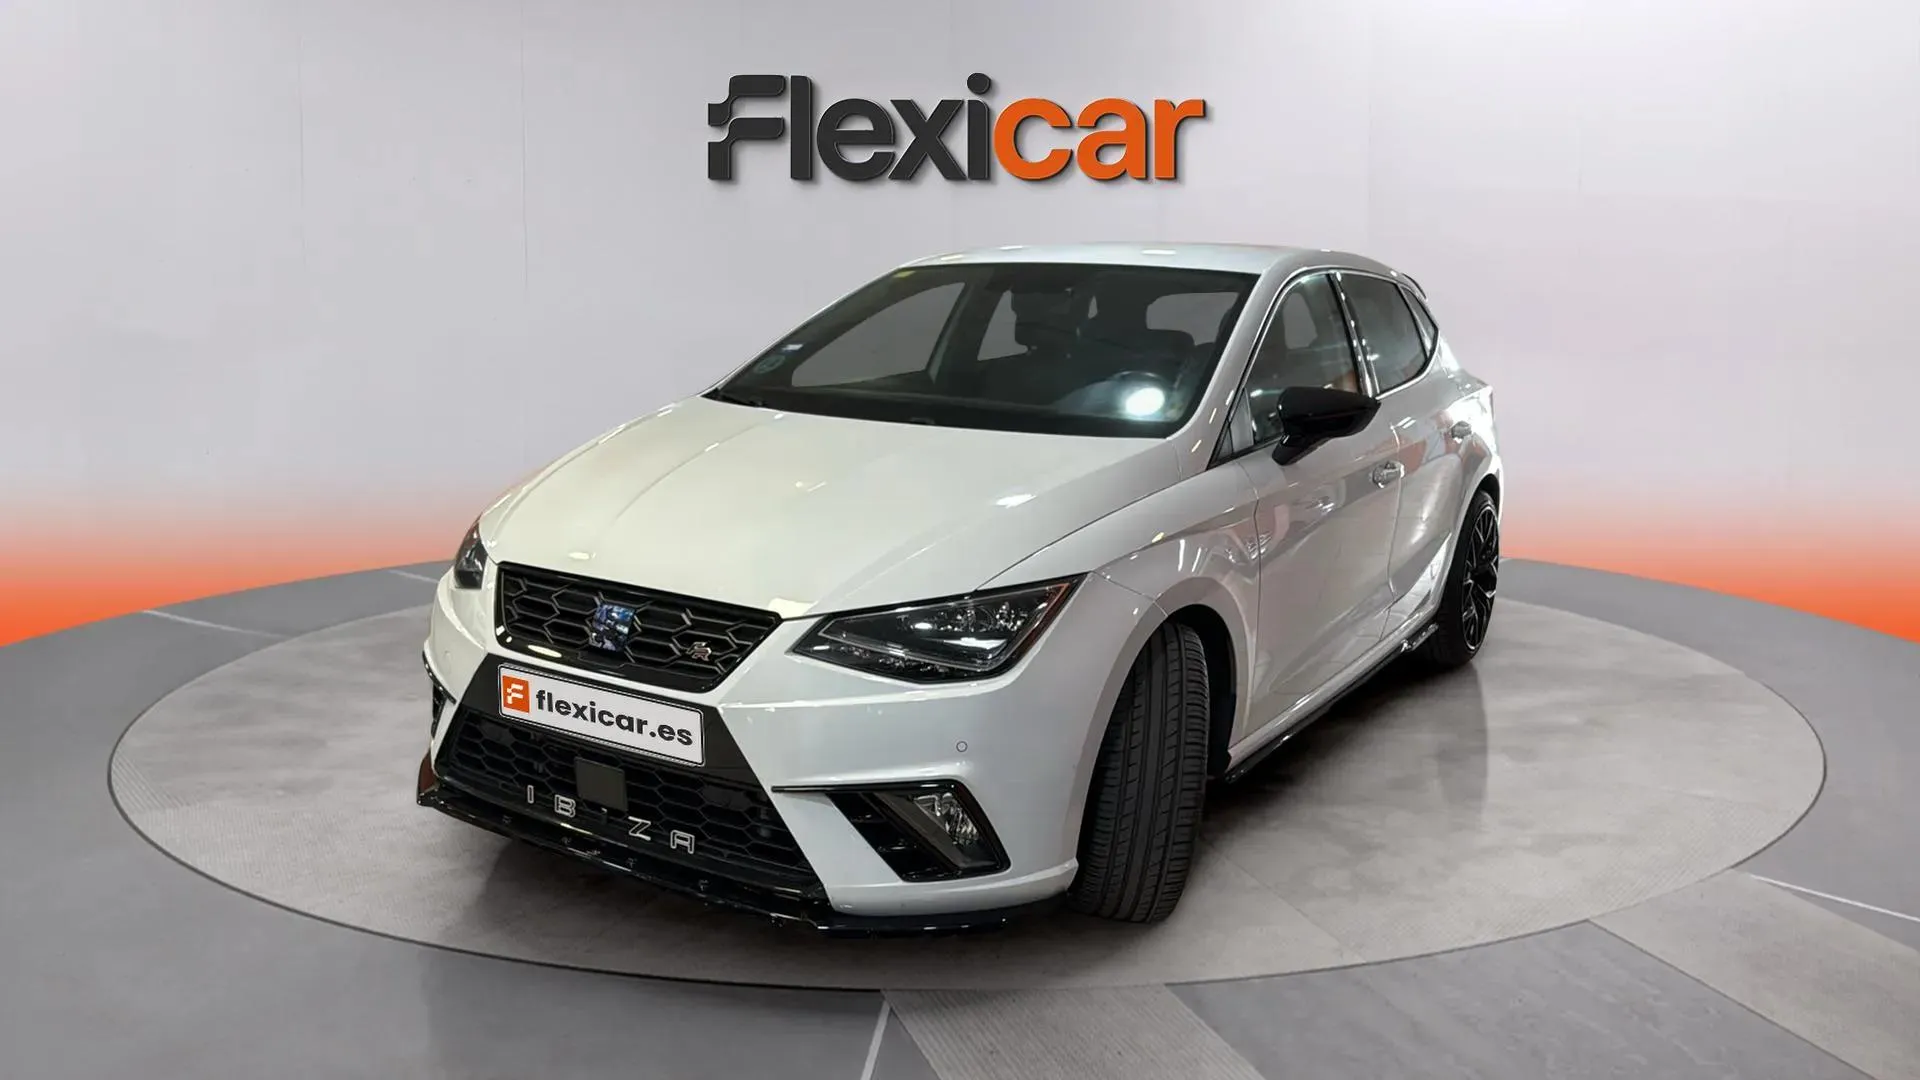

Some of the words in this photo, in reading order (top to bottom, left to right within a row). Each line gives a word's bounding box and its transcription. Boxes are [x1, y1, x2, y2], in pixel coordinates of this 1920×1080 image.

[708, 72, 1206, 181] Flexicar
[535, 689, 694, 746] flexicar.es
[527, 784, 695, 854] IBZA
